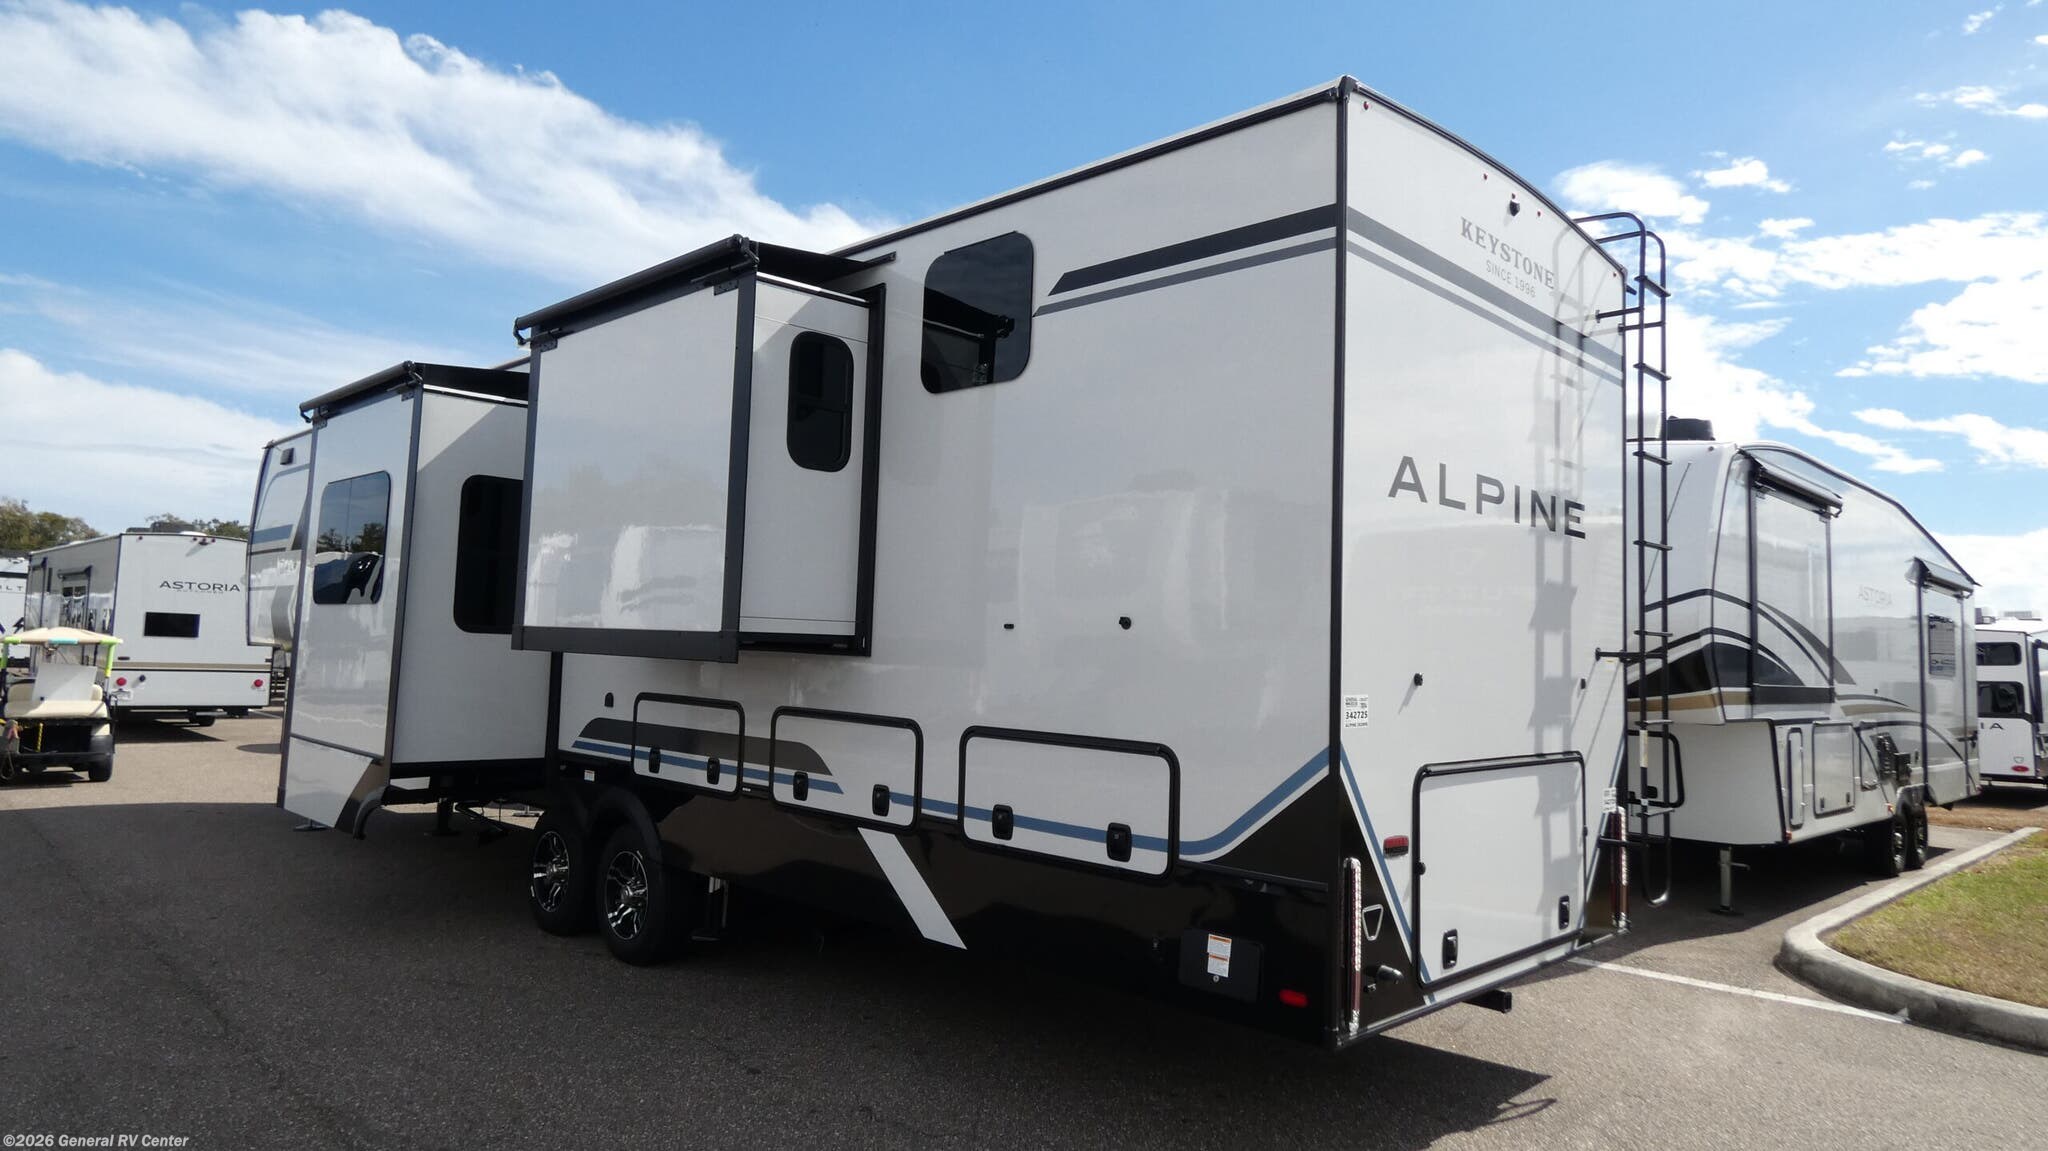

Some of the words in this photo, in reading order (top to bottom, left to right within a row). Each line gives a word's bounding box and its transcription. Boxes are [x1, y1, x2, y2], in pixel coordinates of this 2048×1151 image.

[1460, 216, 1555, 290] KEYSTONE
[1485, 259, 1512, 285] SINCE
[1514, 276, 1536, 298] 1996
[1388, 455, 1586, 540] ALPINE
[159, 580, 241, 592] ASTORIA
[1345, 710, 1368, 720] 342725
